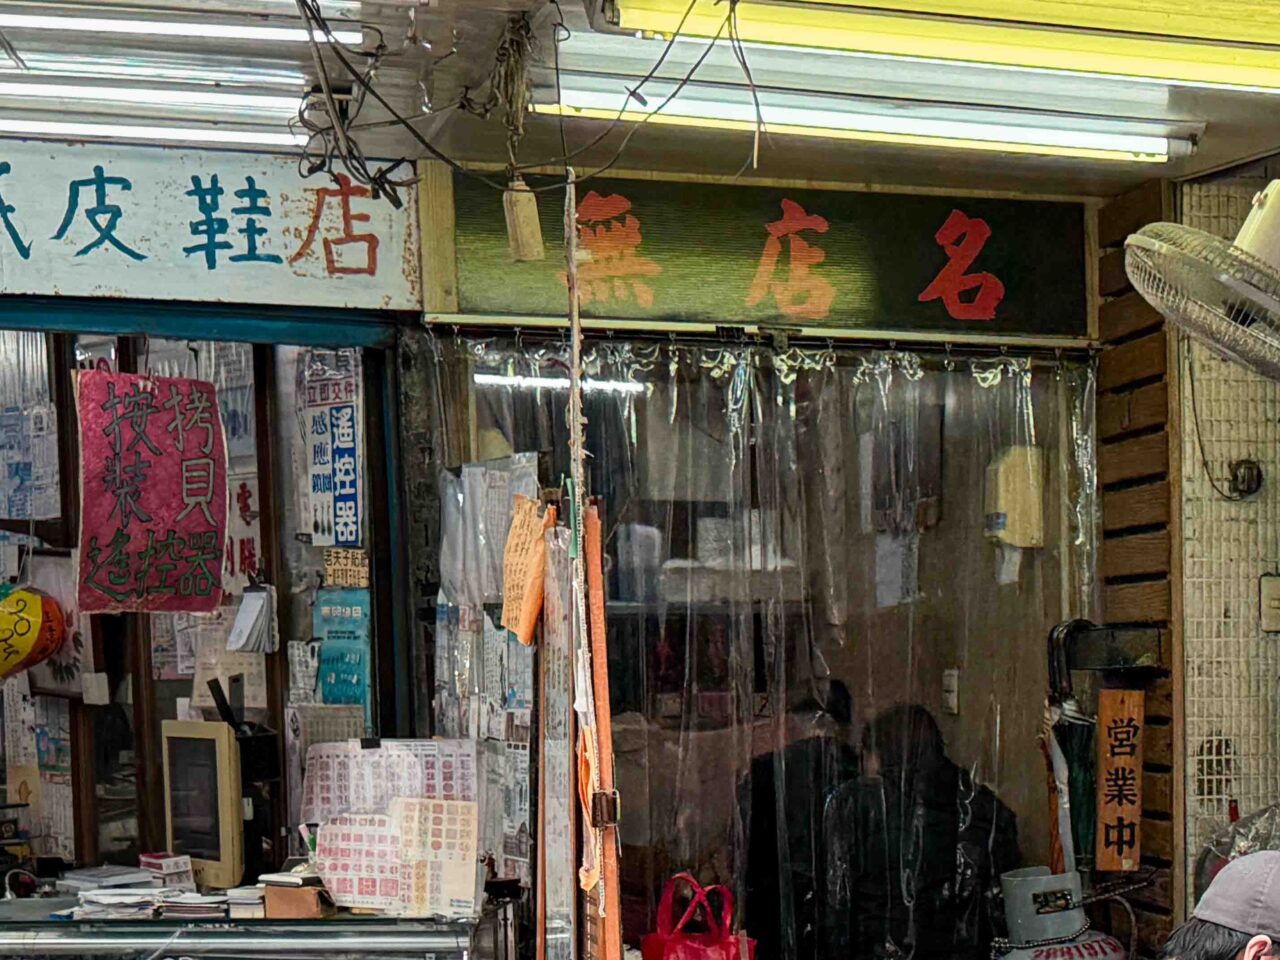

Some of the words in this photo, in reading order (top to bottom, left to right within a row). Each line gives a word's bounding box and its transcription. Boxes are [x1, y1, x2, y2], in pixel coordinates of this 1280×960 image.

[562, 189, 1006, 321] 無店名
[163, 382, 218, 527] 拷貝
[84, 527, 222, 601] 遙控器
